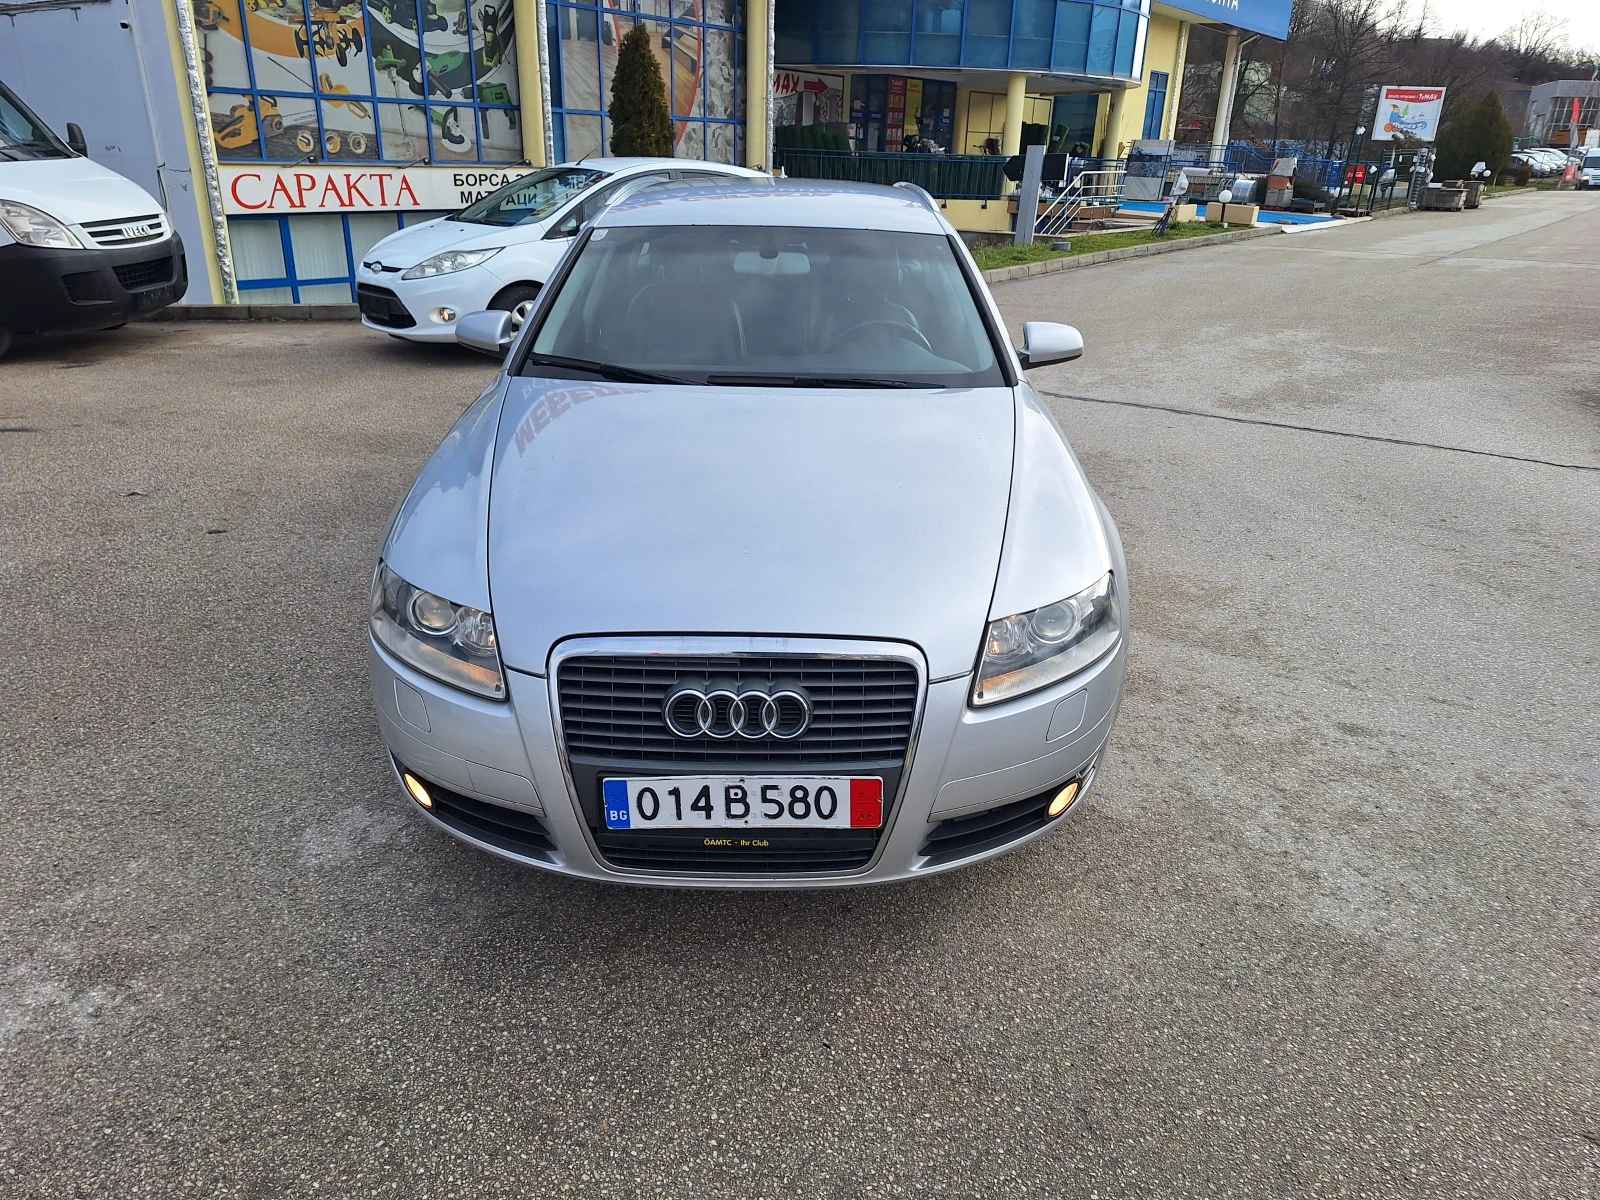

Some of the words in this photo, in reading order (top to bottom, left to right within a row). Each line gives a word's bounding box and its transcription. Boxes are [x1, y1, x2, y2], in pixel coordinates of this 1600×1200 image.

[453, 174, 510, 187] БОРСА
[230, 173, 421, 210] САРАКТА
[121, 225, 151, 238] IVECO
[609, 810, 628, 821] BG
[703, 837, 732, 846] ÖAMTC
[740, 839, 751, 847] Ihr
[752, 839, 769, 847] Club
